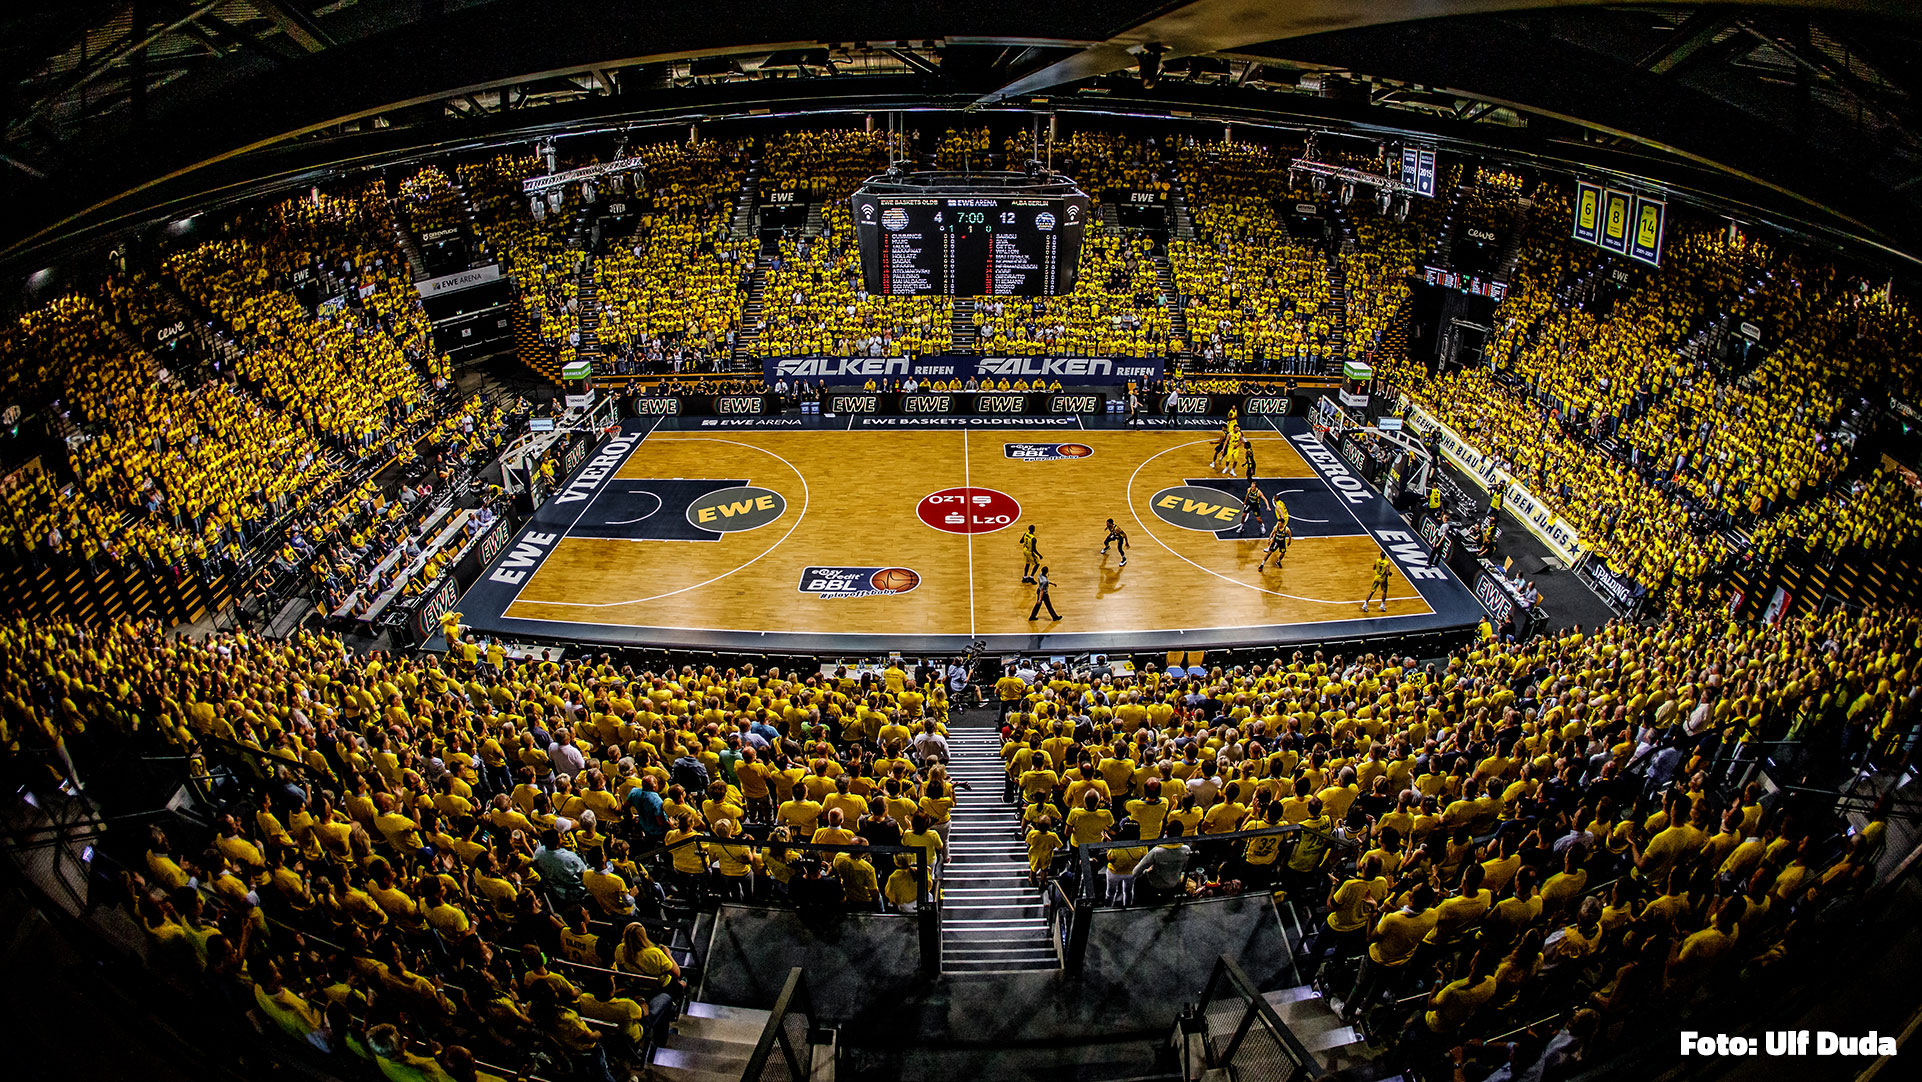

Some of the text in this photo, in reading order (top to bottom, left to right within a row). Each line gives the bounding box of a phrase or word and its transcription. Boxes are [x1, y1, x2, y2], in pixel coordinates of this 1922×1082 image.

[1420, 168, 1432, 178] 2015
[771, 192, 794, 202] EWE
[1131, 192, 1154, 202] EWE
[1585, 203, 1592, 215] 6
[934, 212, 942, 222] 4
[957, 212, 984, 223] 7:00
[1000, 212, 1016, 223] 12
[1613, 211, 1620, 223] 8
[1642, 218, 1654, 234] 14
[1468, 228, 1495, 240] cewe
[294, 268, 309, 282] EWE
[442, 274, 482, 288] EWE ARENA
[1612, 269, 1628, 283] EWE
[158, 321, 184, 340] cewe
[773, 358, 954, 376] FALKEN REIFEN
[974, 358, 1154, 376] FALKEN REIFEN
[638, 398, 677, 414] EWE
[720, 398, 761, 413] EWE
[833, 397, 876, 412] EWE
[905, 397, 950, 412] EWE
[979, 397, 1023, 412] EWE
[1052, 397, 1096, 412] EWE
[1165, 398, 1207, 413] WE
[1248, 398, 1288, 414] EWE
[565, 440, 586, 474] EWE
[1342, 439, 1366, 471] EWE
[554, 432, 641, 504] VIEROL
[1291, 432, 1374, 504] VIEROL
[1456, 447, 1478, 468] BLAU
[1508, 488, 1534, 514] LBEN
[1534, 514, 1568, 545] JUNGS
[698, 495, 775, 524] EWE
[1157, 495, 1240, 521] EWE
[973, 515, 1010, 524] LzO
[481, 520, 510, 565] EWE
[489, 531, 557, 584] EWE
[1375, 530, 1448, 580] EWE
[807, 580, 857, 590] BBL
[1592, 564, 1630, 603] SPALDING
[423, 578, 456, 632] EWE
[1476, 575, 1512, 620] EWE
[1260, 838, 1277, 850] 32
